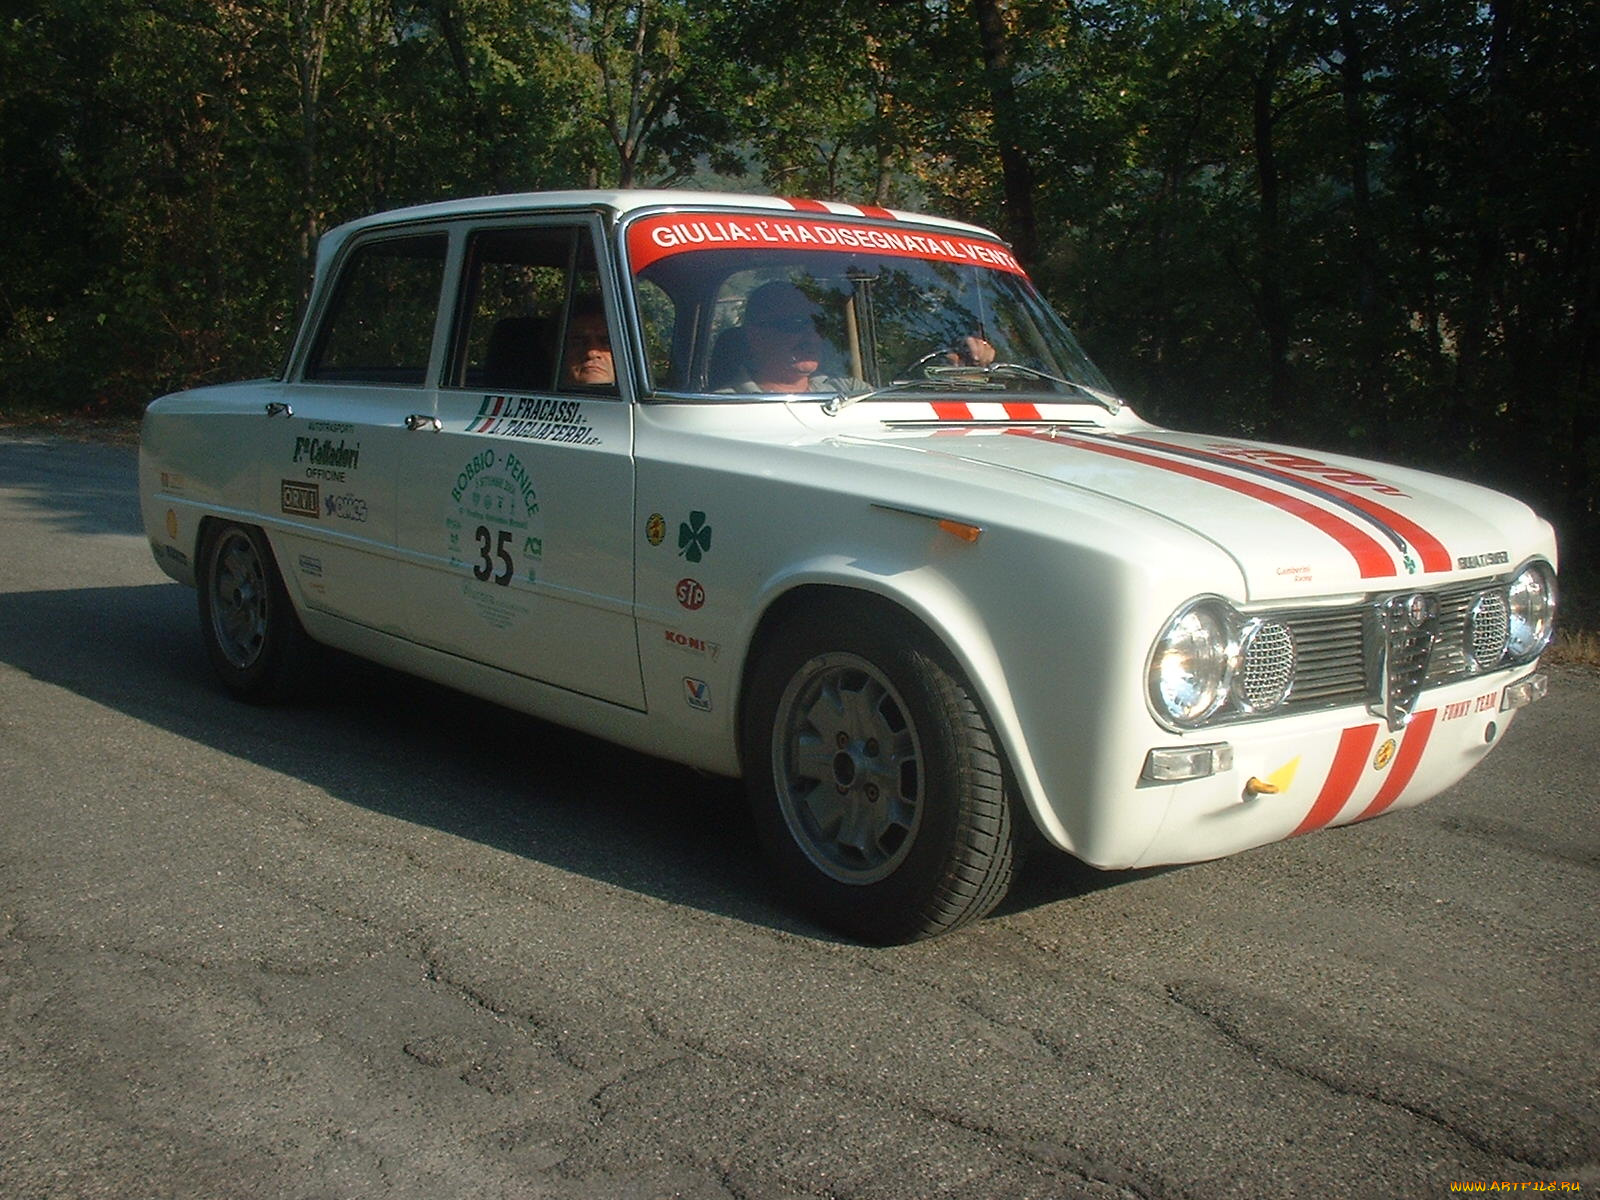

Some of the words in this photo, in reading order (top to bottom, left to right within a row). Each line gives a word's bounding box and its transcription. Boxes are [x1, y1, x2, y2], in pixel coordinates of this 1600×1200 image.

[651, 221, 757, 247] GIULIA:
[774, 223, 819, 244] HA
[813, 226, 946, 256] DISEGNATA
[940, 240, 967, 259] IL
[306, 467, 345, 483] OFFICINE
[451, 449, 495, 503] BOBBIO
[505, 452, 540, 518] PENICE
[473, 525, 514, 586] 35
[678, 580, 704, 605] STP
[665, 629, 706, 652] KONI
[1474, 691, 1498, 713] TEAM
